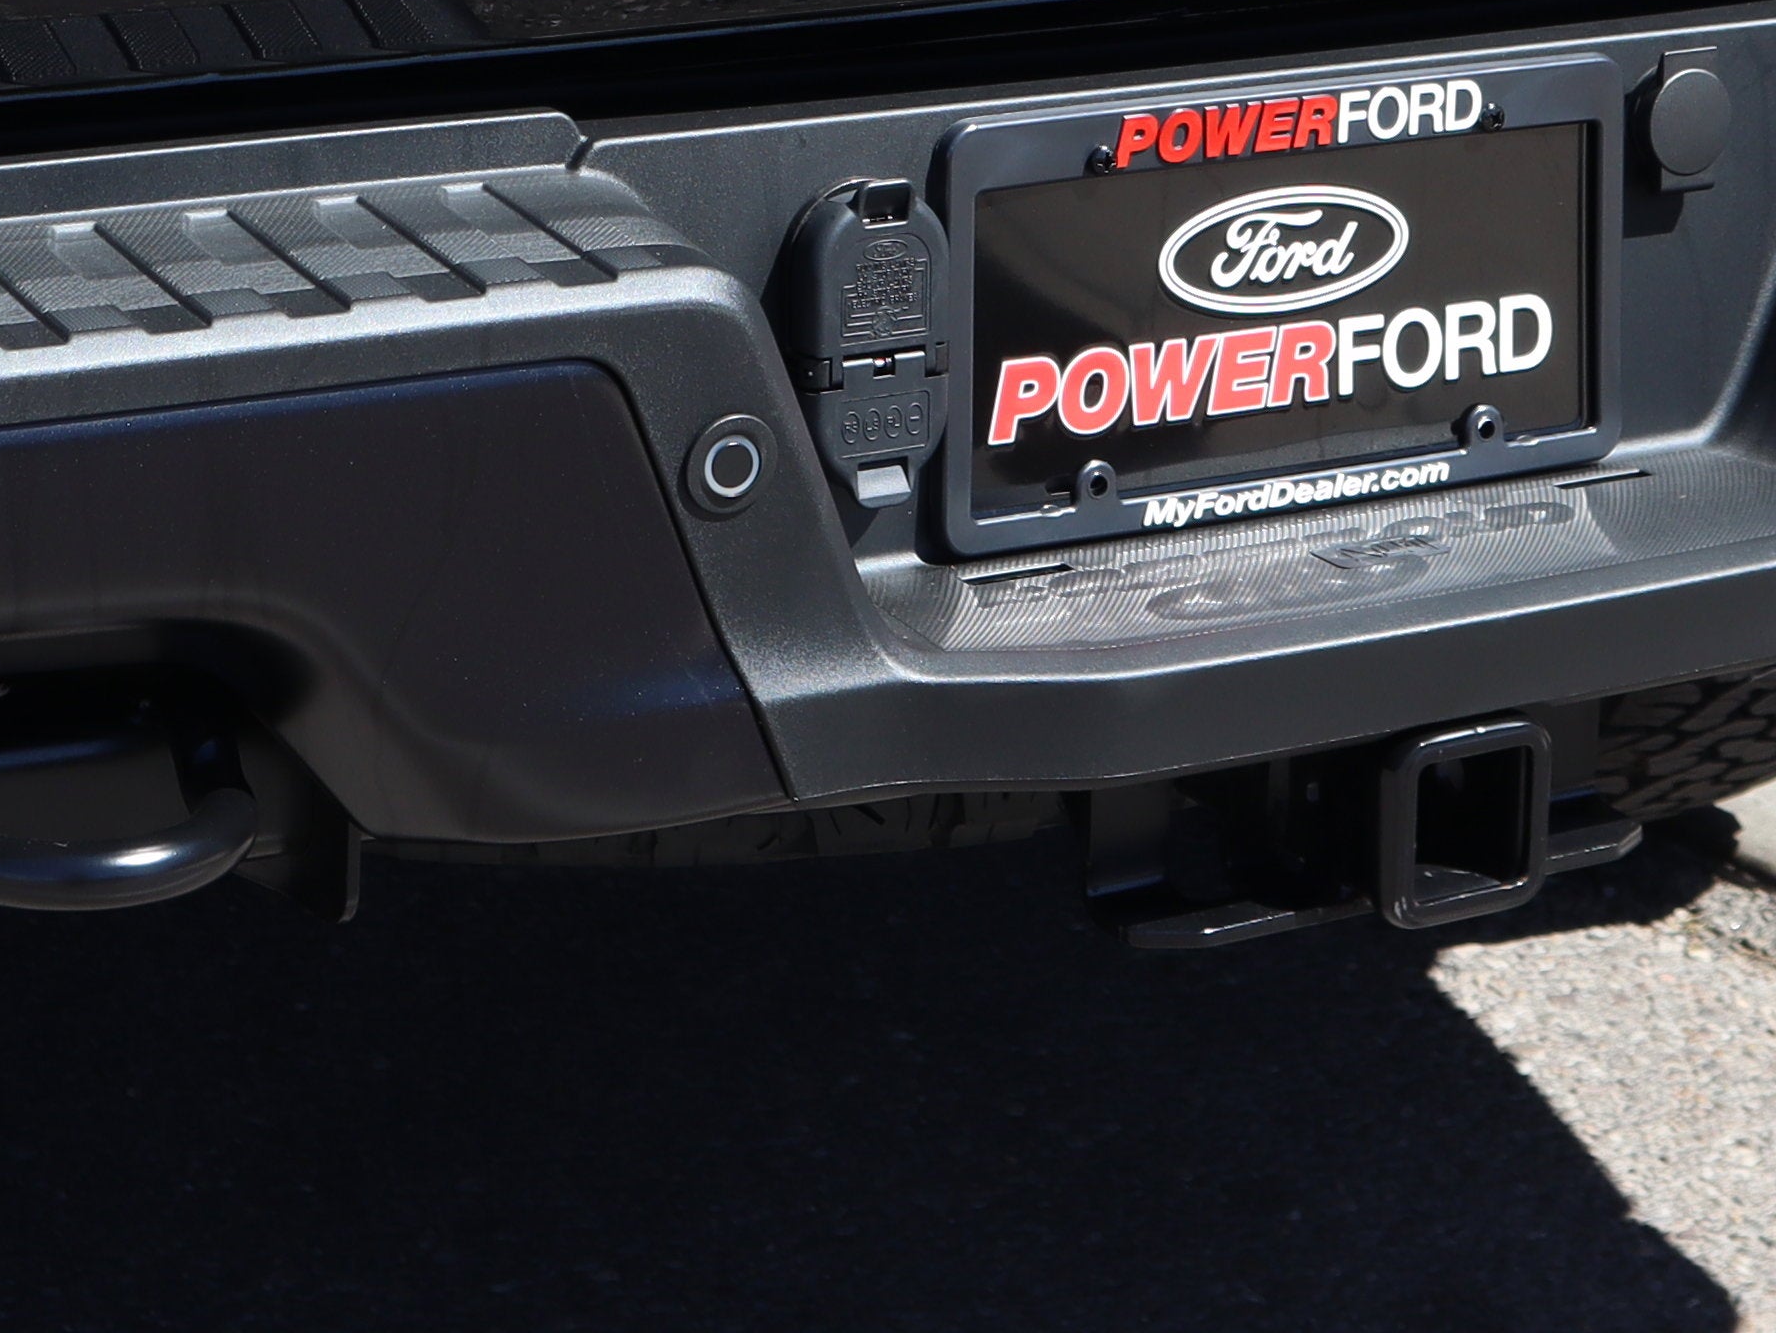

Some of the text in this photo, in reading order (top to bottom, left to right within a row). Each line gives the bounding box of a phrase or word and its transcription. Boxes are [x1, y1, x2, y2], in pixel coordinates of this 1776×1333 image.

[1115, 79, 1484, 170] POWERFORD
[1210, 209, 1359, 289] Ford
[987, 293, 1554, 447] POWERFORD
[1142, 462, 1450, 529] MyFordDealer.com
